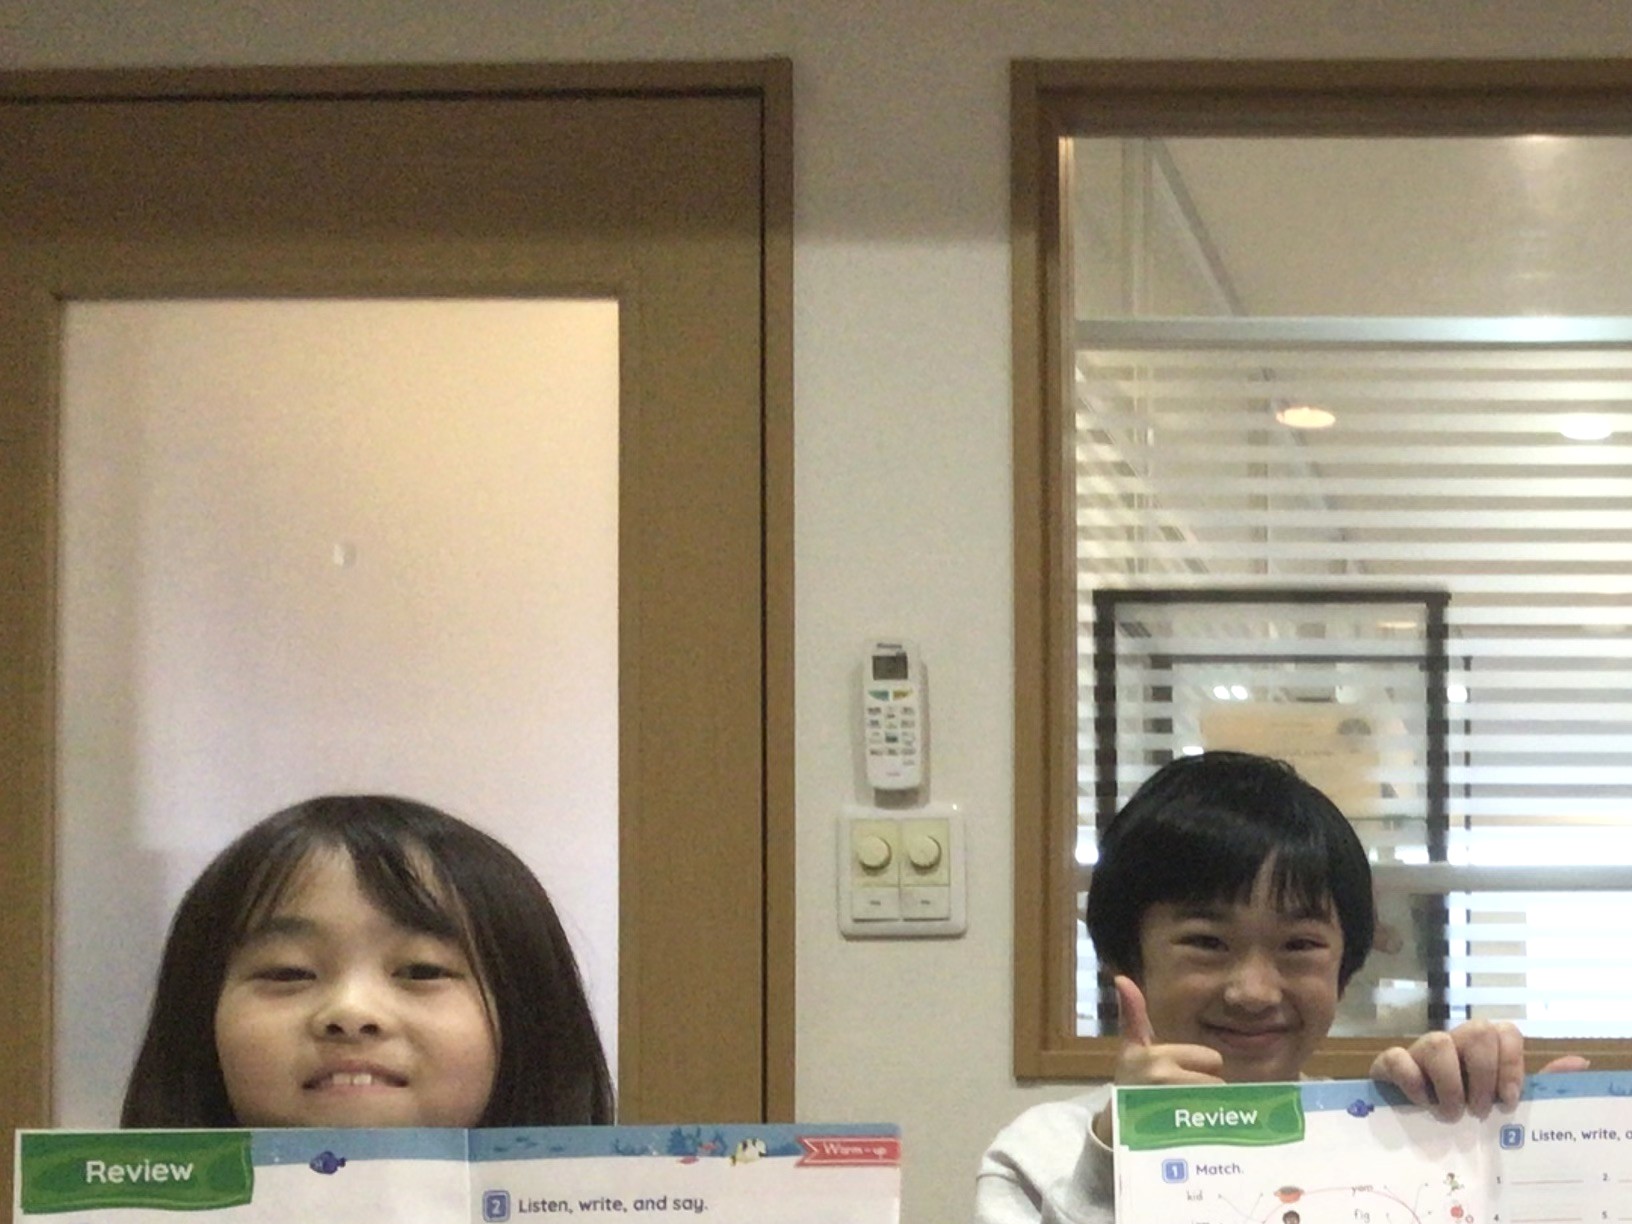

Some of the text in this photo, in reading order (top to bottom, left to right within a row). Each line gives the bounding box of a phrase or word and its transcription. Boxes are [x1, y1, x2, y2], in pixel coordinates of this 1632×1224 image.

[1174, 1107, 1258, 1127] Review
[1531, 1129, 1577, 1142] Listen,
[1581, 1128, 1621, 1142] write,
[85, 1159, 195, 1184] Review
[1195, 1163, 1244, 1176] Match.
[1187, 1191, 1203, 1202] kid
[518, 1196, 709, 1214] Listen, write, and say.
[1354, 1209, 1370, 1223] fig
